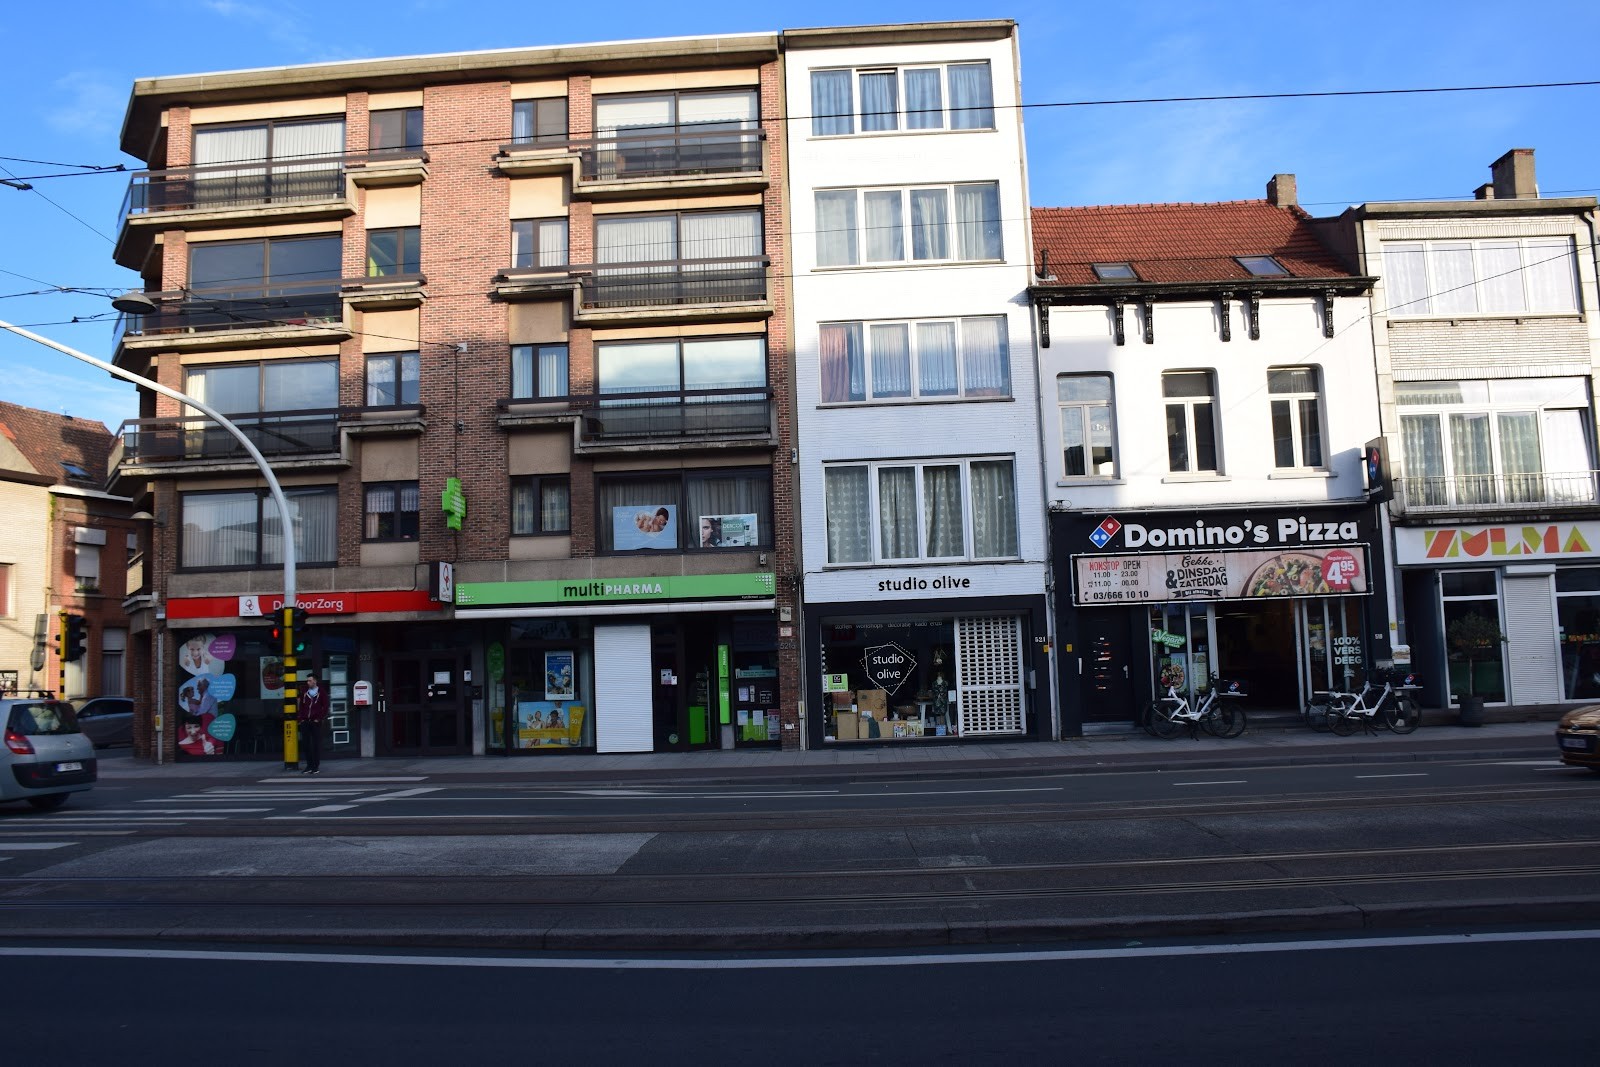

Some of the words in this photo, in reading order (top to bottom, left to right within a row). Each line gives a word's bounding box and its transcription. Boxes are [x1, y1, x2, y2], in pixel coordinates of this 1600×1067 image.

[1124, 519, 1269, 548] Domino's
[1277, 516, 1359, 542] Pizza
[1424, 525, 1592, 558] ZULMA
[1089, 561, 1120, 571] NONSTOP
[1123, 560, 1141, 570] OPEN
[1182, 555, 1214, 567] Gekke
[1177, 566, 1227, 580] DINSDAG
[878, 577, 927, 591] studio
[932, 575, 970, 588] olive
[1180, 573, 1228, 588] ZATERDAG
[1093, 591, 1123, 600] 03/666
[1126, 590, 1136, 598] 10
[1138, 590, 1149, 598] 10
[1333, 636, 1361, 646] 100%
[1334, 646, 1361, 655] VERS
[872, 653, 904, 665] studio
[1334, 656, 1362, 665] DEEG
[876, 668, 901, 680] olive
